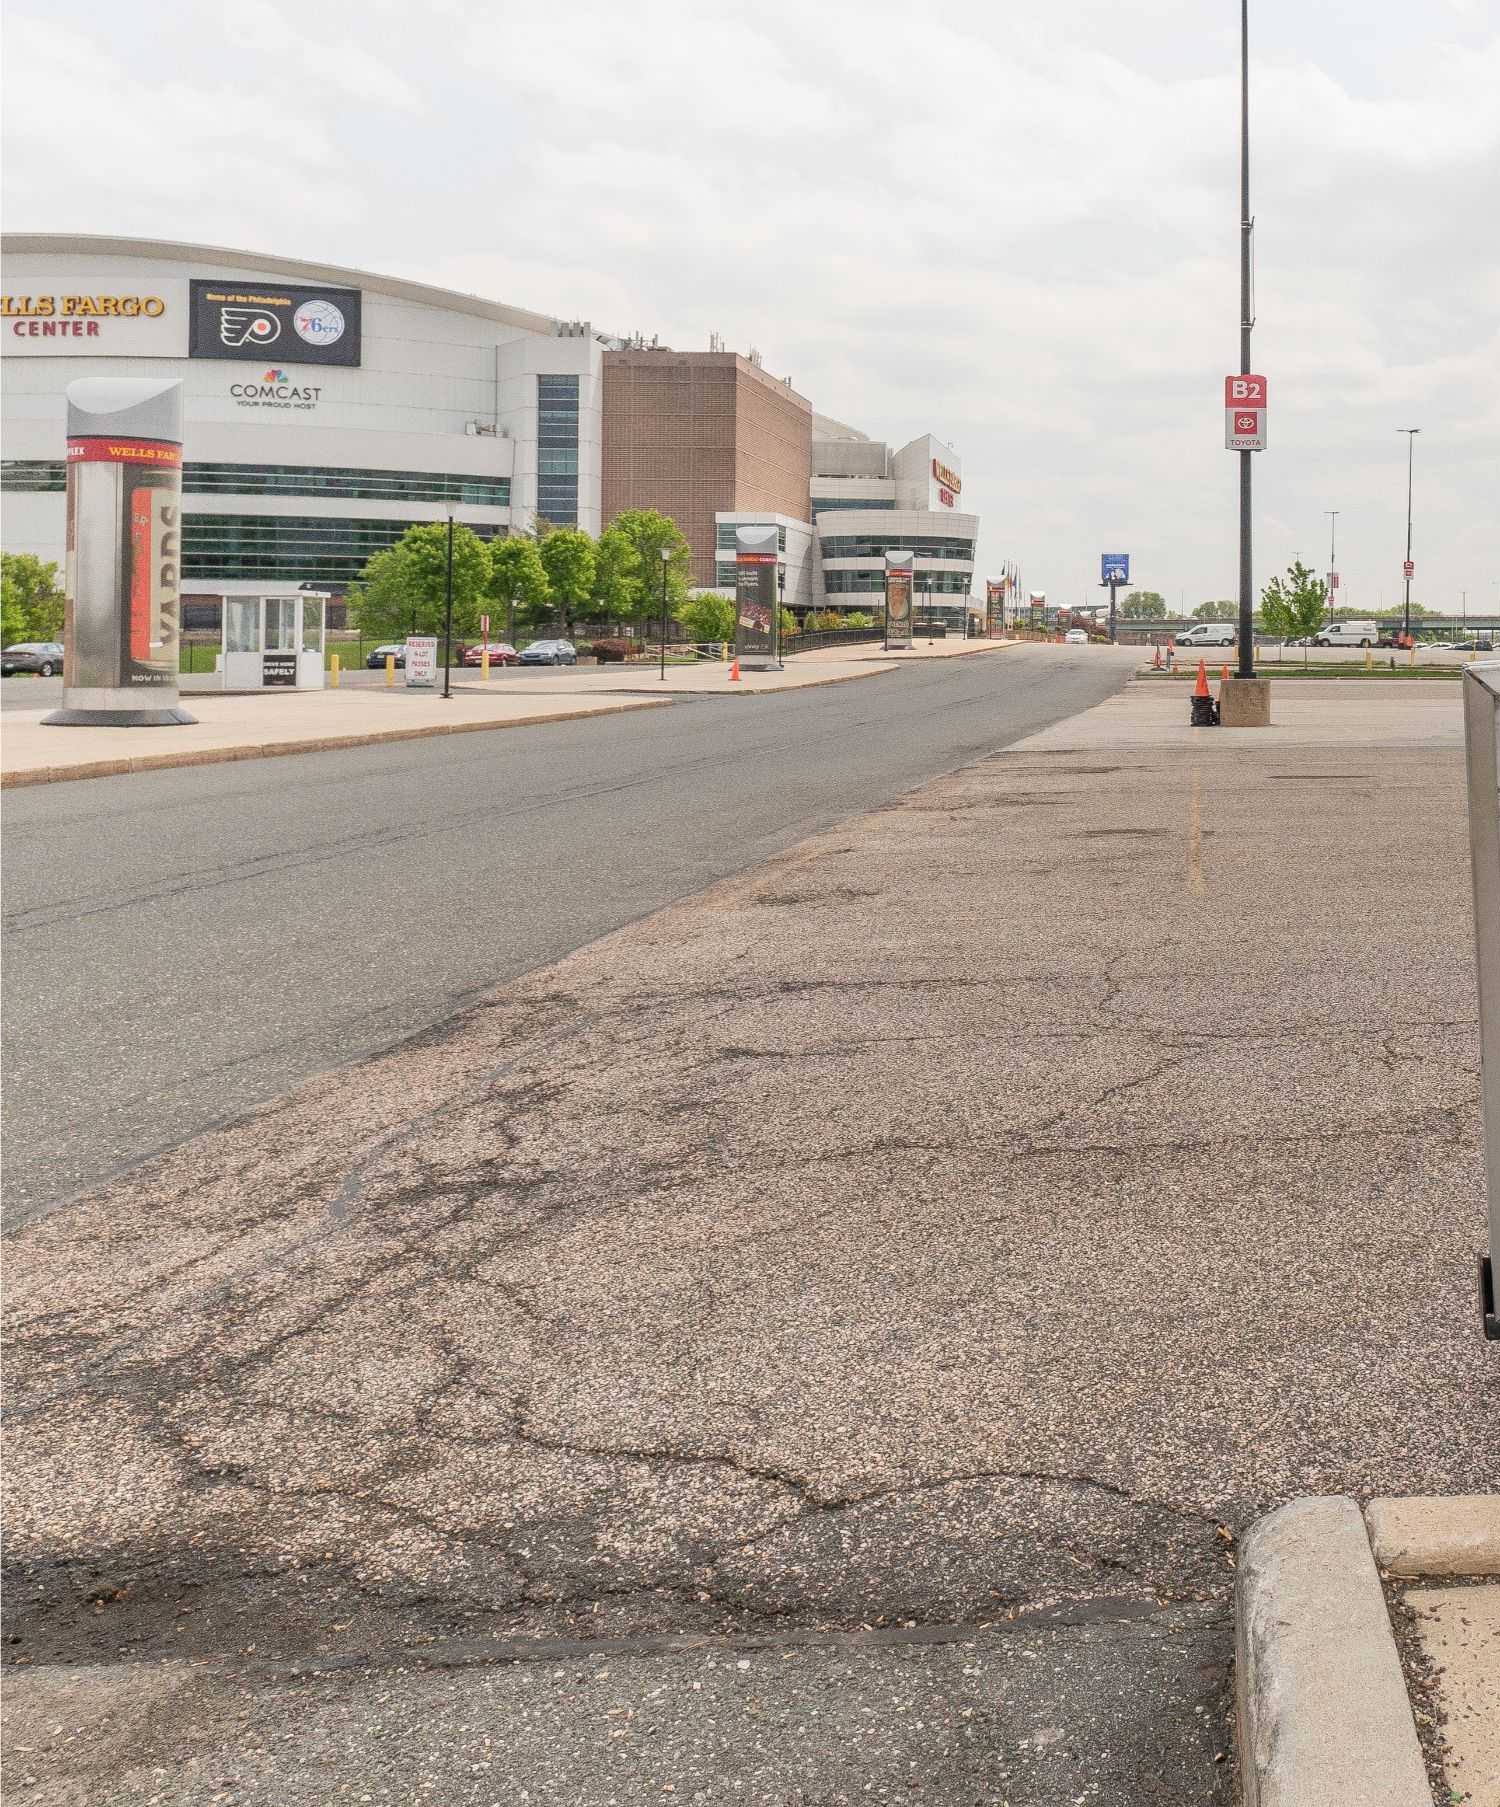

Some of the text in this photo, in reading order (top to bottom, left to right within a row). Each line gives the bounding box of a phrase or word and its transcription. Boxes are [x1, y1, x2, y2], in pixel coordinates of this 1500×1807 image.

[0, 296, 166, 317] LLS FARGO
[13, 320, 101, 338] CENTER
[230, 384, 322, 401] COMCAST
[1232, 381, 1261, 399] B2
[262, 401, 292, 409] PROUD
[108, 447, 155, 459] WELLS
